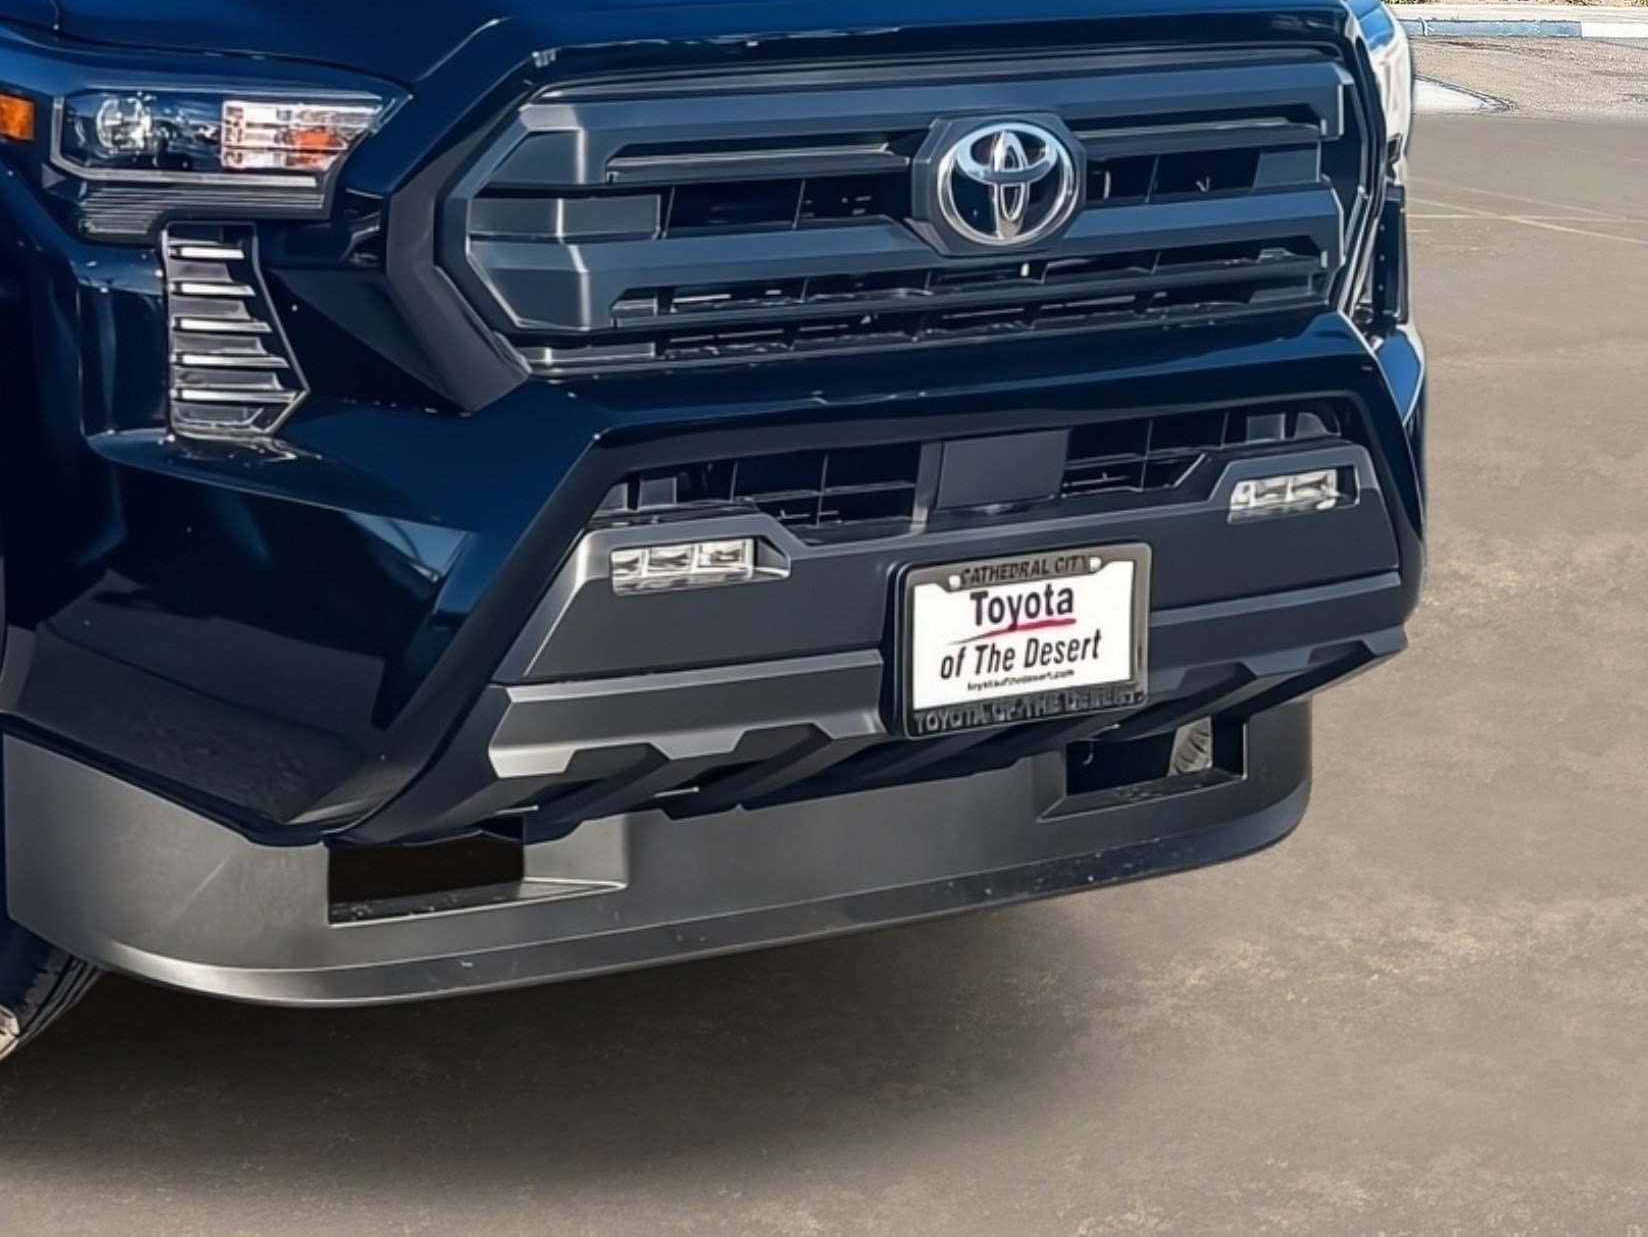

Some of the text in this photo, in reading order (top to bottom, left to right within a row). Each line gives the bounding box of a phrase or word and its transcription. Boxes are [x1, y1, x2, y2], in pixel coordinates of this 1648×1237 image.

[960, 555, 1091, 586] CATHEDRAL CITY
[969, 583, 1075, 631] Toyota
[940, 628, 1103, 680] of The Desert
[913, 705, 987, 735] TOYOTA
